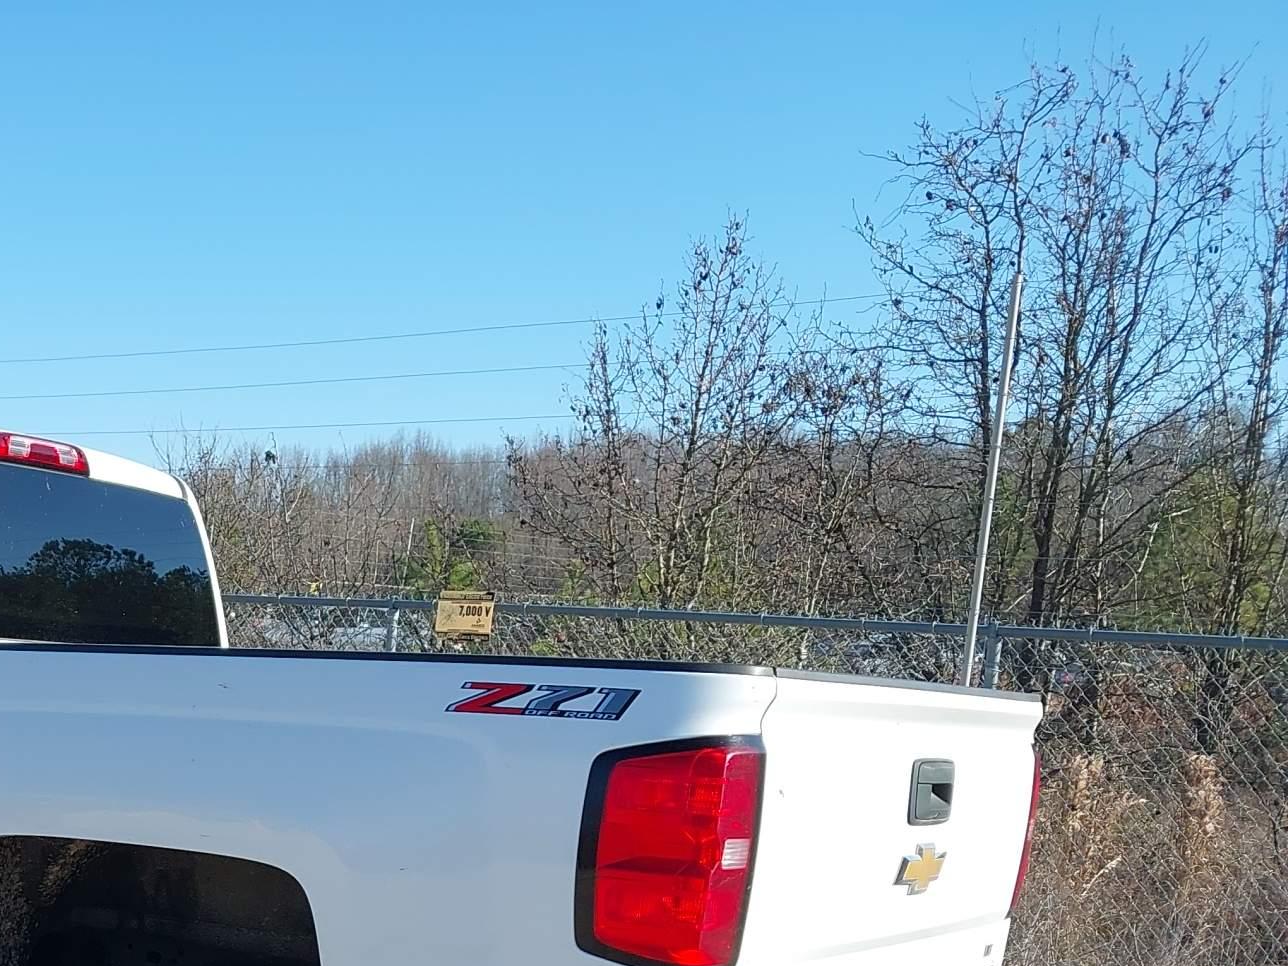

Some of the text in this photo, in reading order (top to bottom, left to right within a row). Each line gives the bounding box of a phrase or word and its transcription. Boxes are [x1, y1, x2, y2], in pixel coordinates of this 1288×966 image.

[459, 605, 491, 618] 7,000 V
[444, 681, 643, 721] Z71
[524, 709, 617, 720] OFF ROAD
